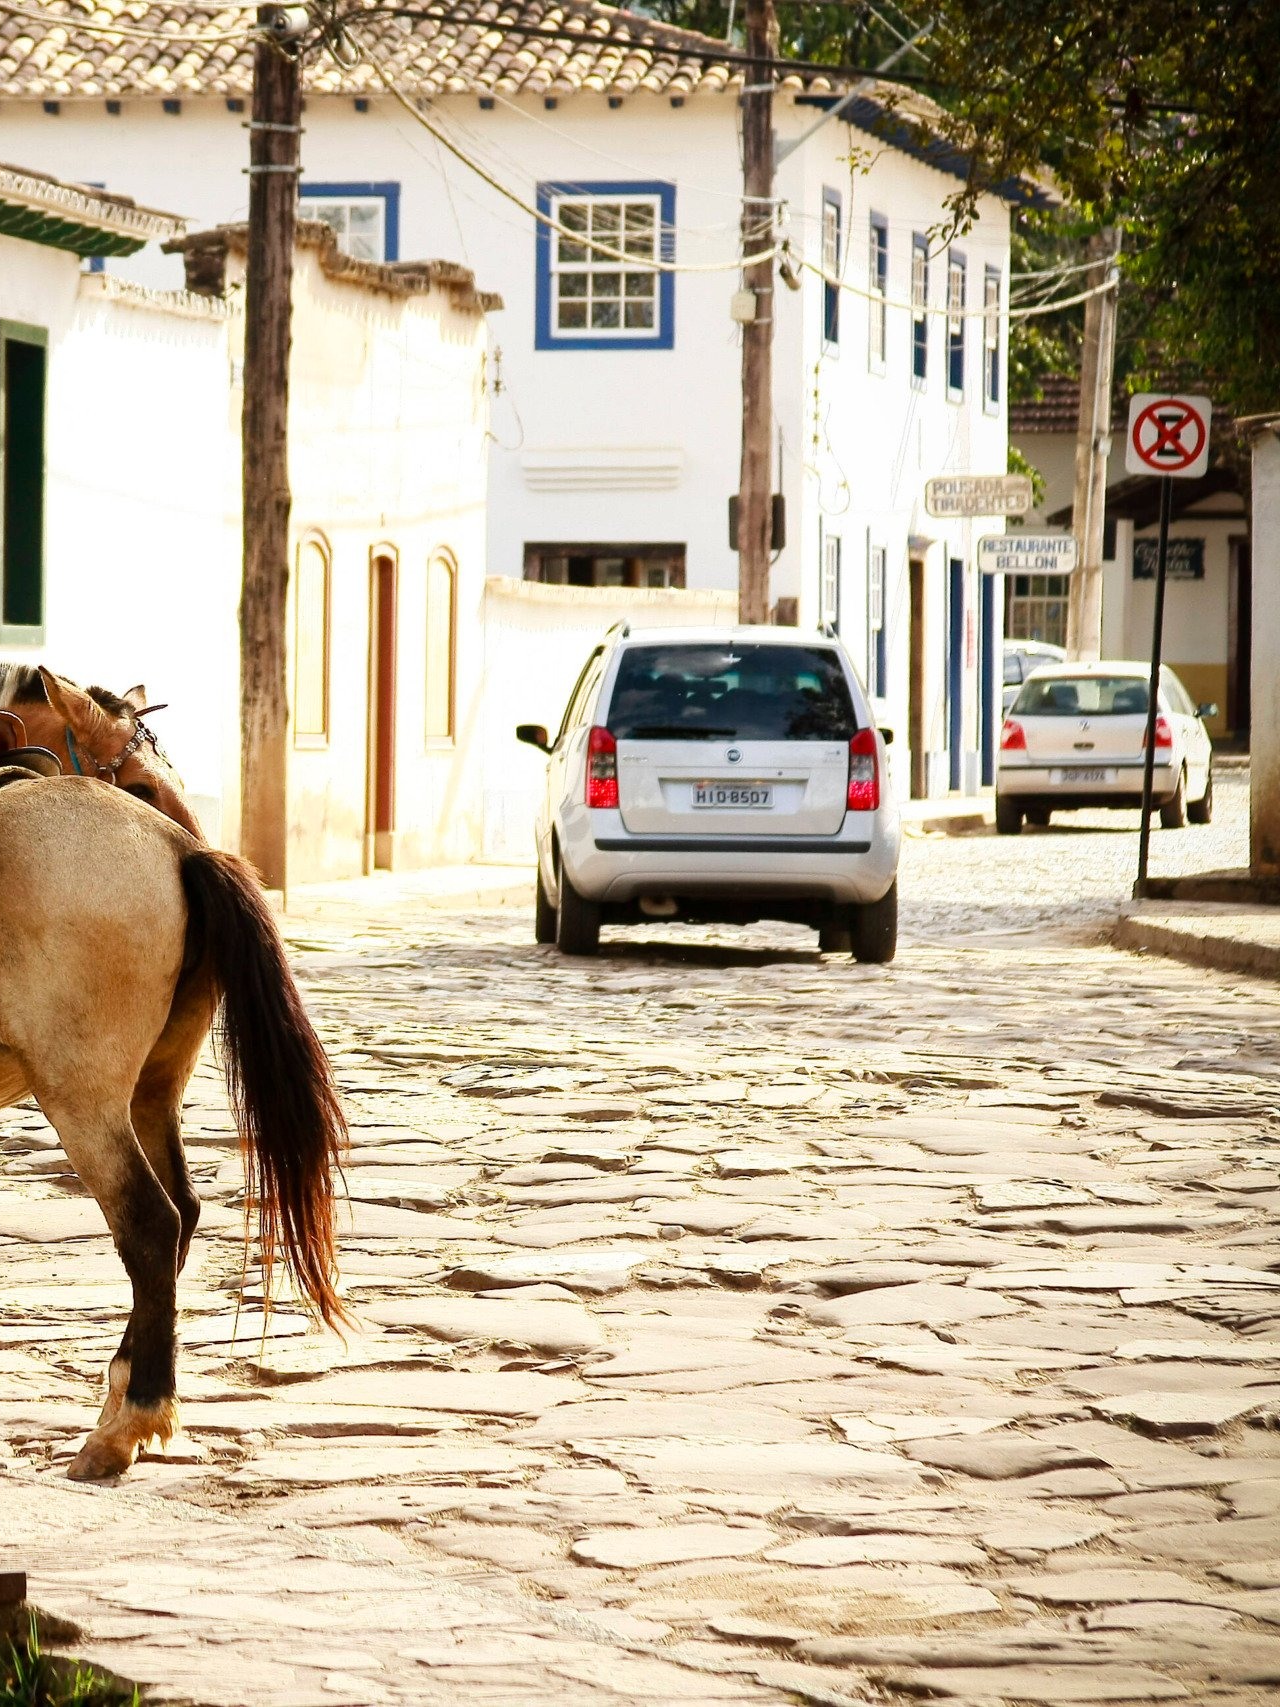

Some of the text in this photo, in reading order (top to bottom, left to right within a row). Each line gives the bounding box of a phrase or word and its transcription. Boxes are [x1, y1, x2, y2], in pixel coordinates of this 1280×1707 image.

[933, 481, 1003, 494] POUSADA
[931, 496, 1026, 511] TIRADENTES
[983, 540, 1072, 553] RESTAURANTE
[997, 556, 1058, 569] BELLONI
